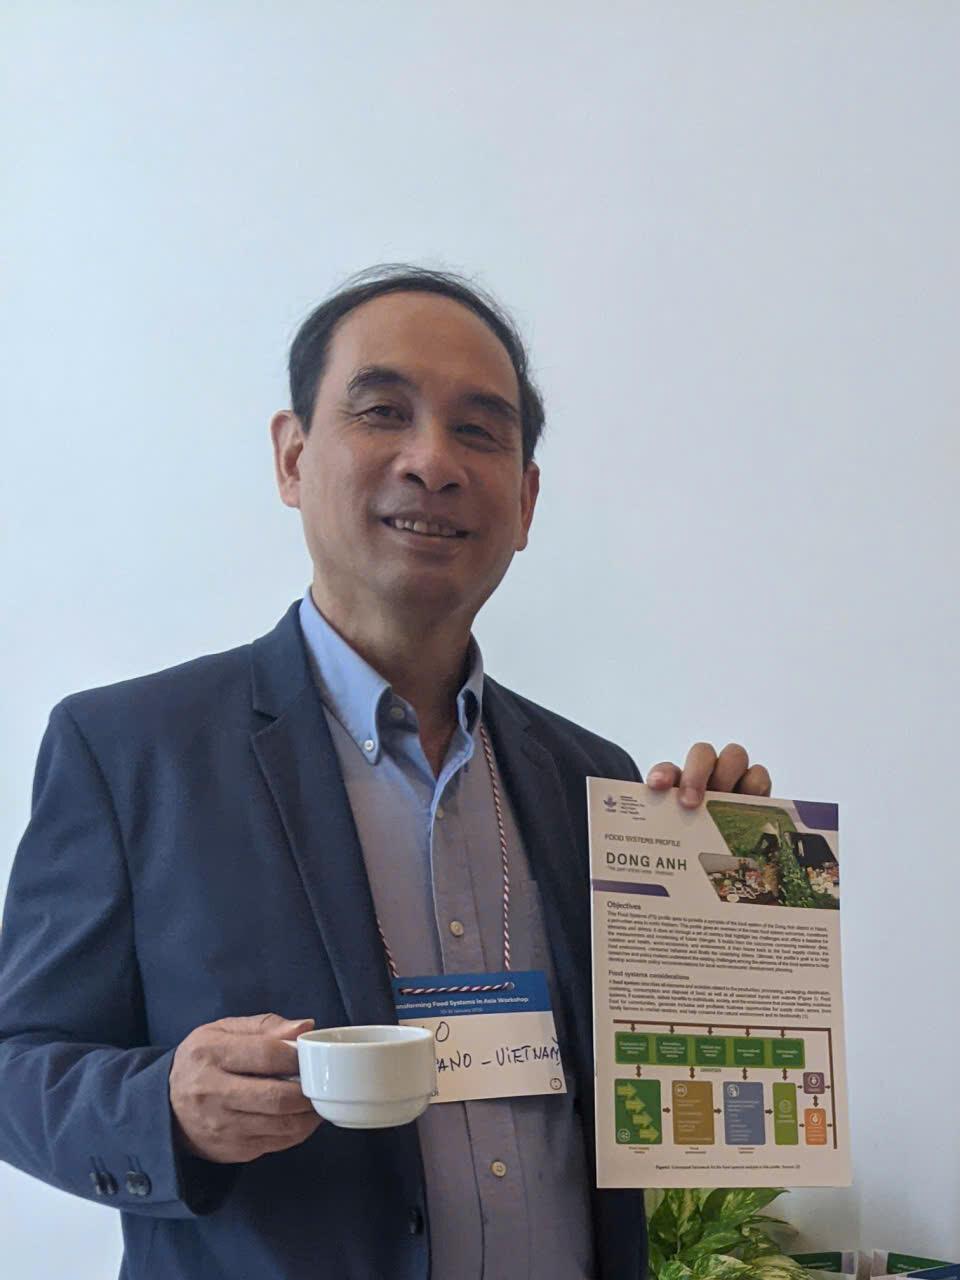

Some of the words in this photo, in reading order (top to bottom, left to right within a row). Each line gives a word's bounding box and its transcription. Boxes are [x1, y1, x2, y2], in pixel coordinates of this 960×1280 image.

[606, 851, 650, 868] DONG
[656, 856, 687, 872] ANH
[607, 900, 642, 910] Objectives
